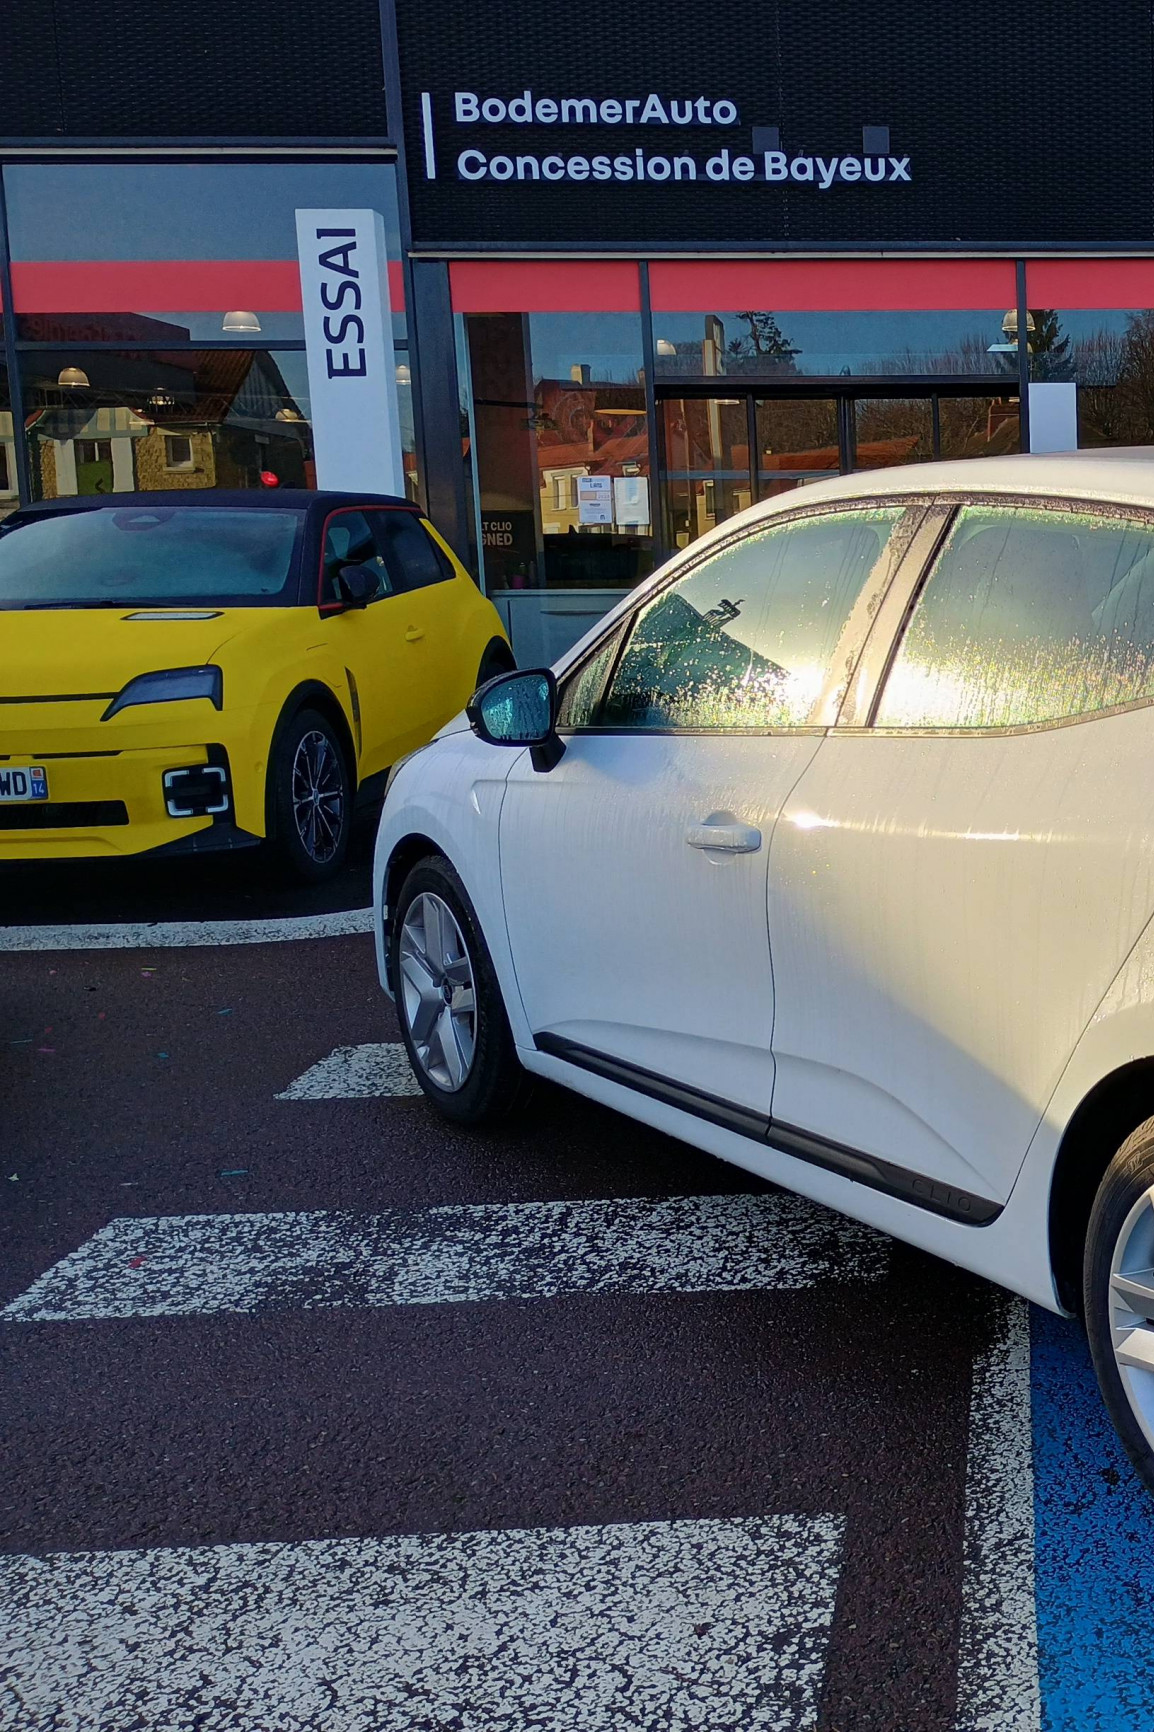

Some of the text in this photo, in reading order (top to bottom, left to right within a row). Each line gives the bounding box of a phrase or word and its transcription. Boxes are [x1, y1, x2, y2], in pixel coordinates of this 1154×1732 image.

[454, 90, 738, 125] BodemerAuto
[457, 148, 912, 190] Concession de Bayeux
[316, 228, 367, 380] ESSAI
[490, 521, 512, 531] CLIO
[33, 782, 45, 794] 14
[912, 1178, 971, 1212] CLIO
